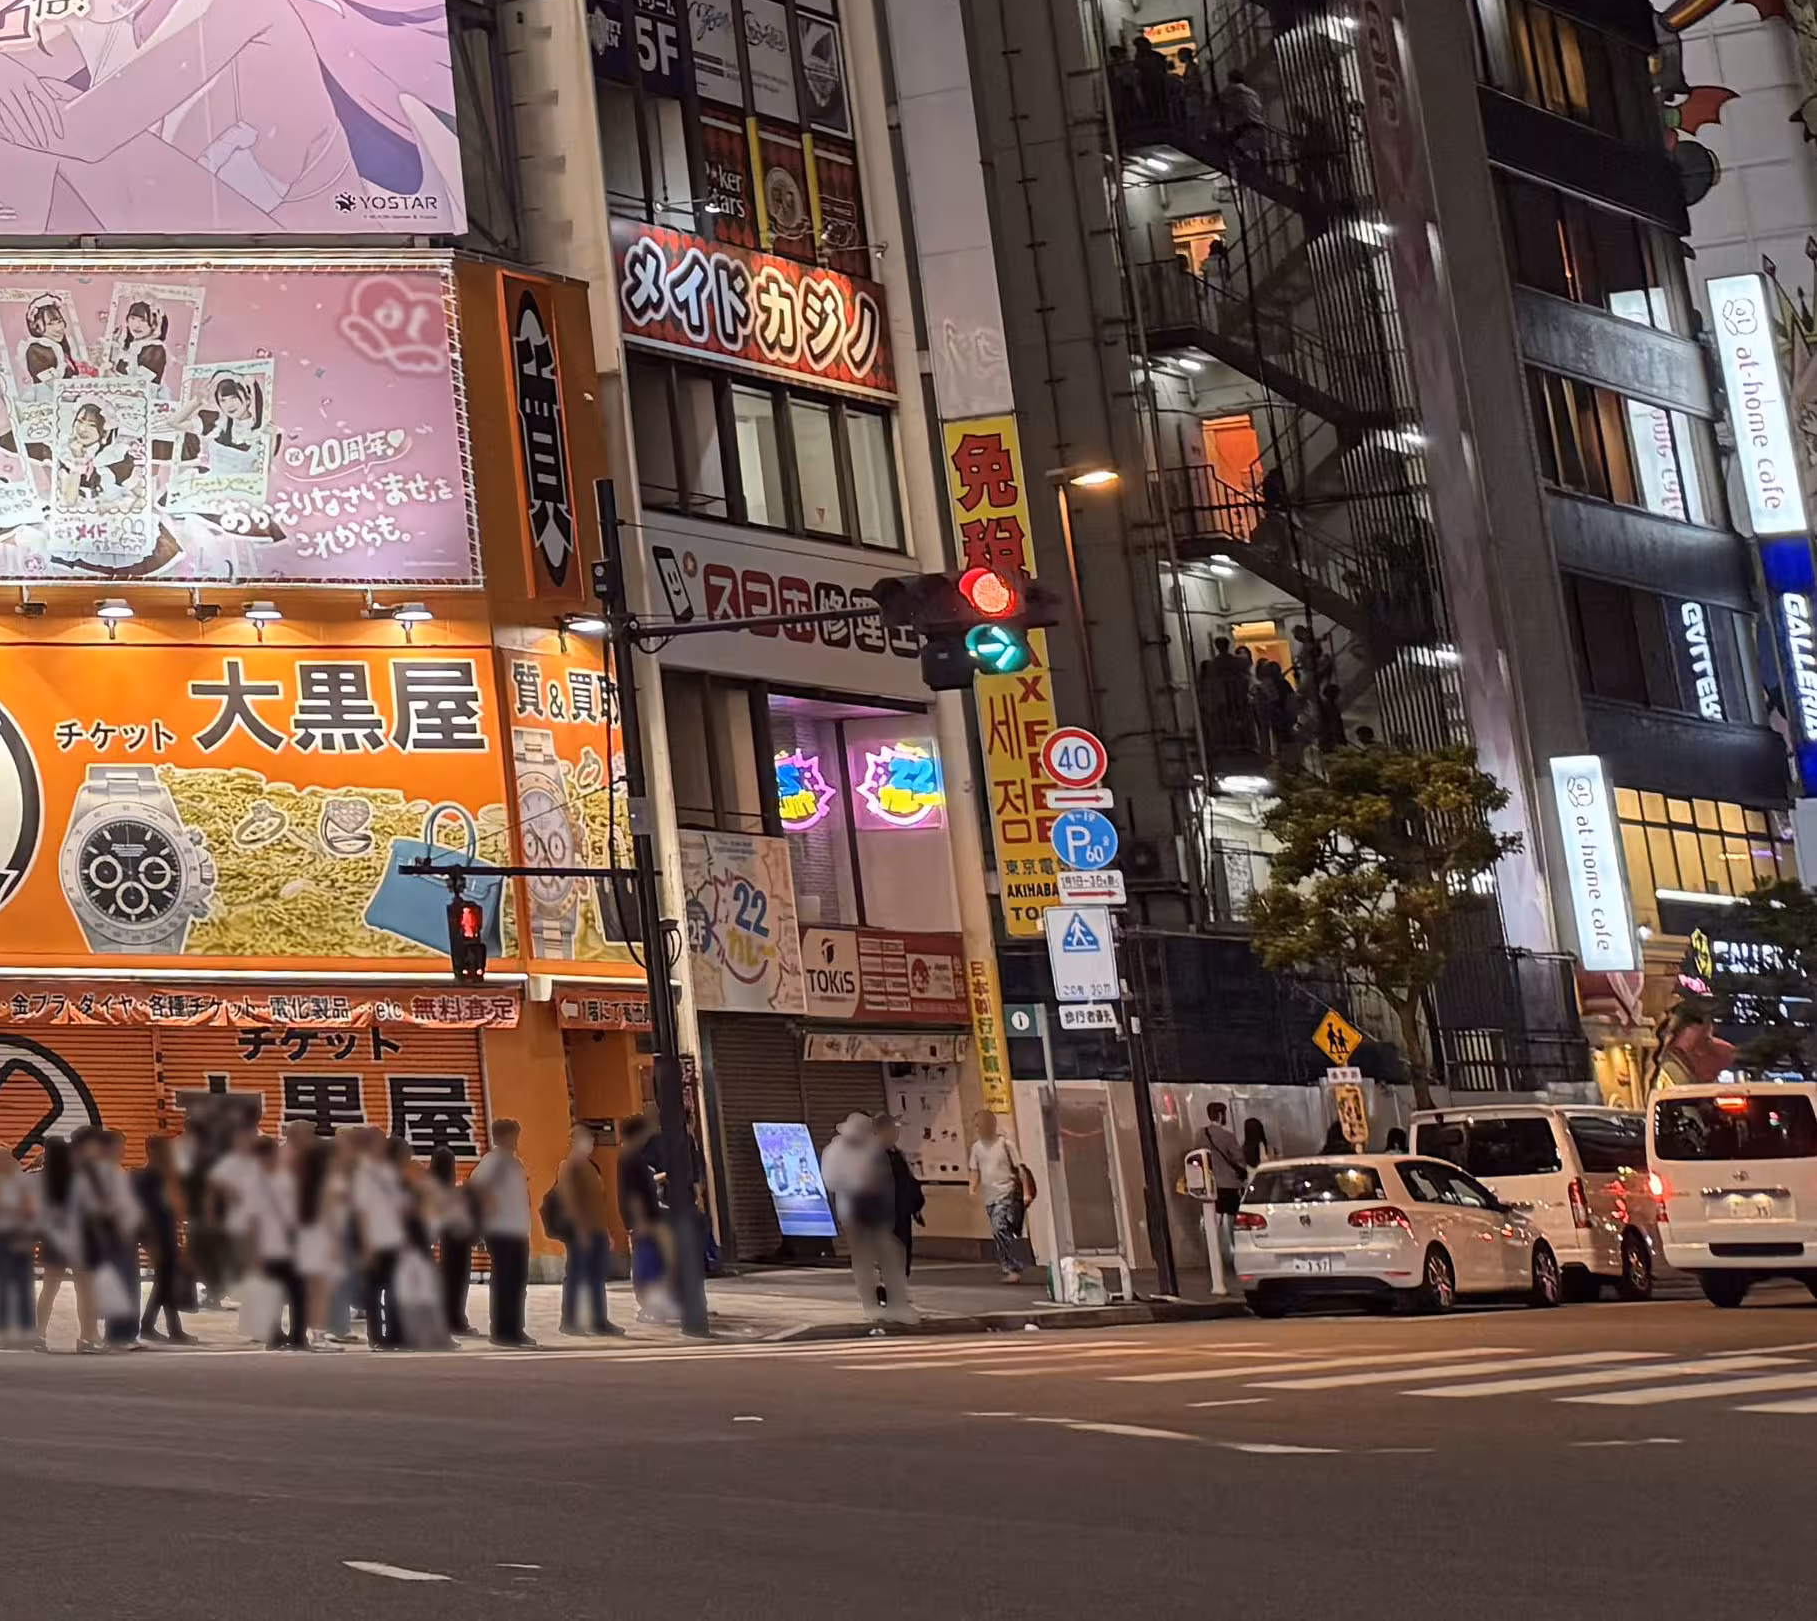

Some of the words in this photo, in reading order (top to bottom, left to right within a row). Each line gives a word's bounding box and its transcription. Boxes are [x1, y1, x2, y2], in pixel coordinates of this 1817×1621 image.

[634, 15, 679, 76] 5F
[359, 192, 440, 212] YOSTAR
[621, 235, 880, 379] メイドカジノ
[1756, 457, 1785, 511] cafe
[296, 514, 412, 560] これからも。
[188, 656, 490, 756] 大黒屋
[54, 717, 178, 752] チケット
[1057, 744, 1092, 772] 40
[1065, 825, 1092, 864] P
[732, 881, 771, 939] 22
[411, 994, 517, 1026] 無料査定
[236, 1027, 402, 1064] チケット
